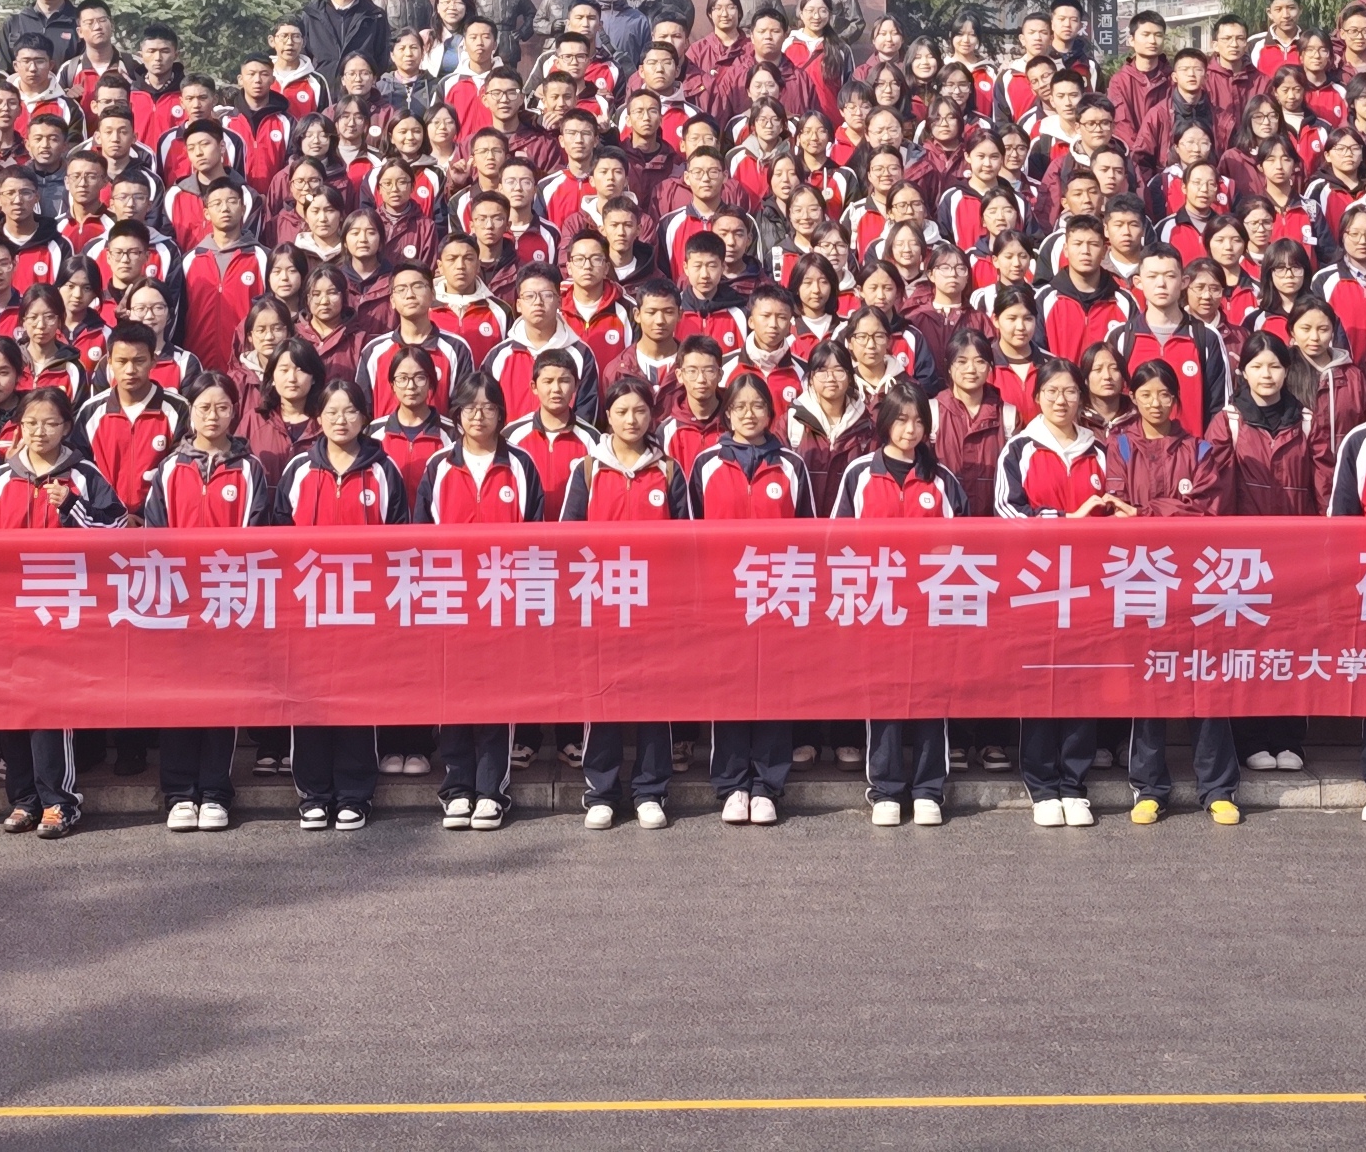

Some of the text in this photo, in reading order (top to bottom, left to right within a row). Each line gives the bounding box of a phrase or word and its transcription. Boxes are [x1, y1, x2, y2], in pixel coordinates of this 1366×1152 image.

[15, 546, 648, 630] 寻迹新征程精神
[733, 545, 1274, 629] 铸就奋斗脊梁
